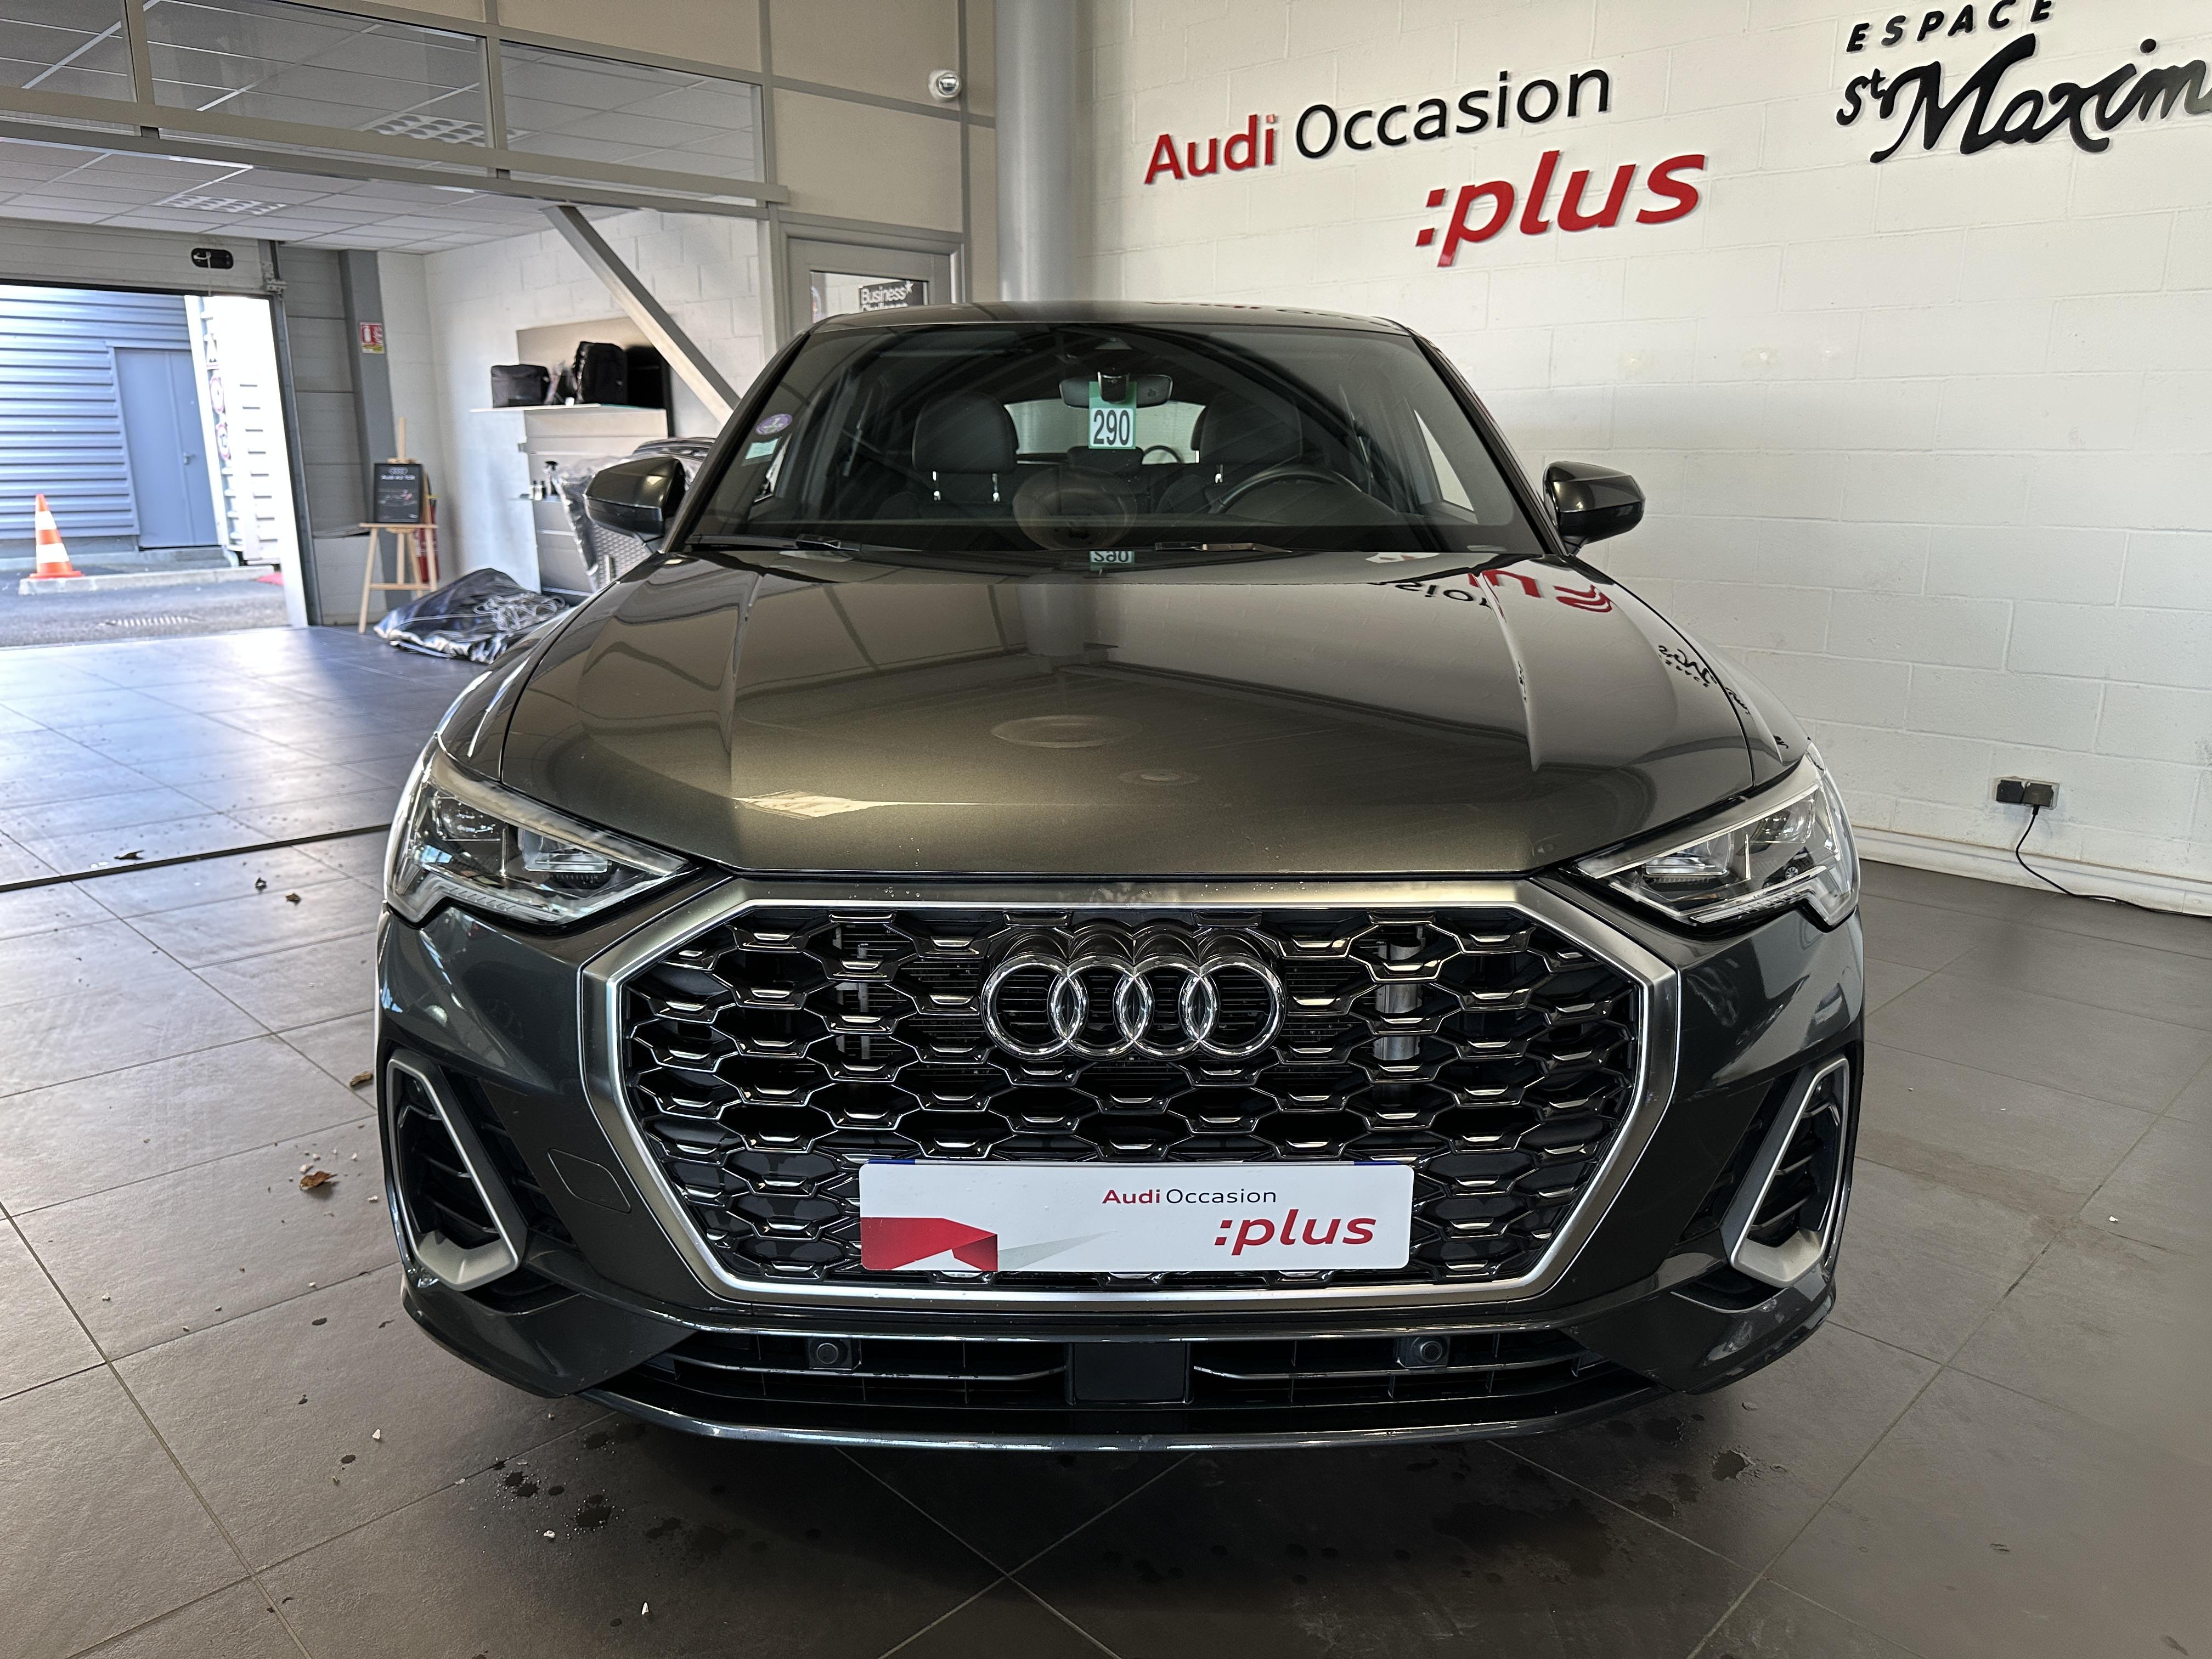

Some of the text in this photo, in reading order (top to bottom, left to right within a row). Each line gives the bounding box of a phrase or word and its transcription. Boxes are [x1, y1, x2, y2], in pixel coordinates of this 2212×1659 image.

[1846, 0, 2052, 52] ESPACE
[1144, 69, 1610, 184] Audi Occasion
[860, 285, 907, 304] Business
[1093, 409, 1130, 445] 290
[1102, 1189, 1277, 1204] Audi Occasion
